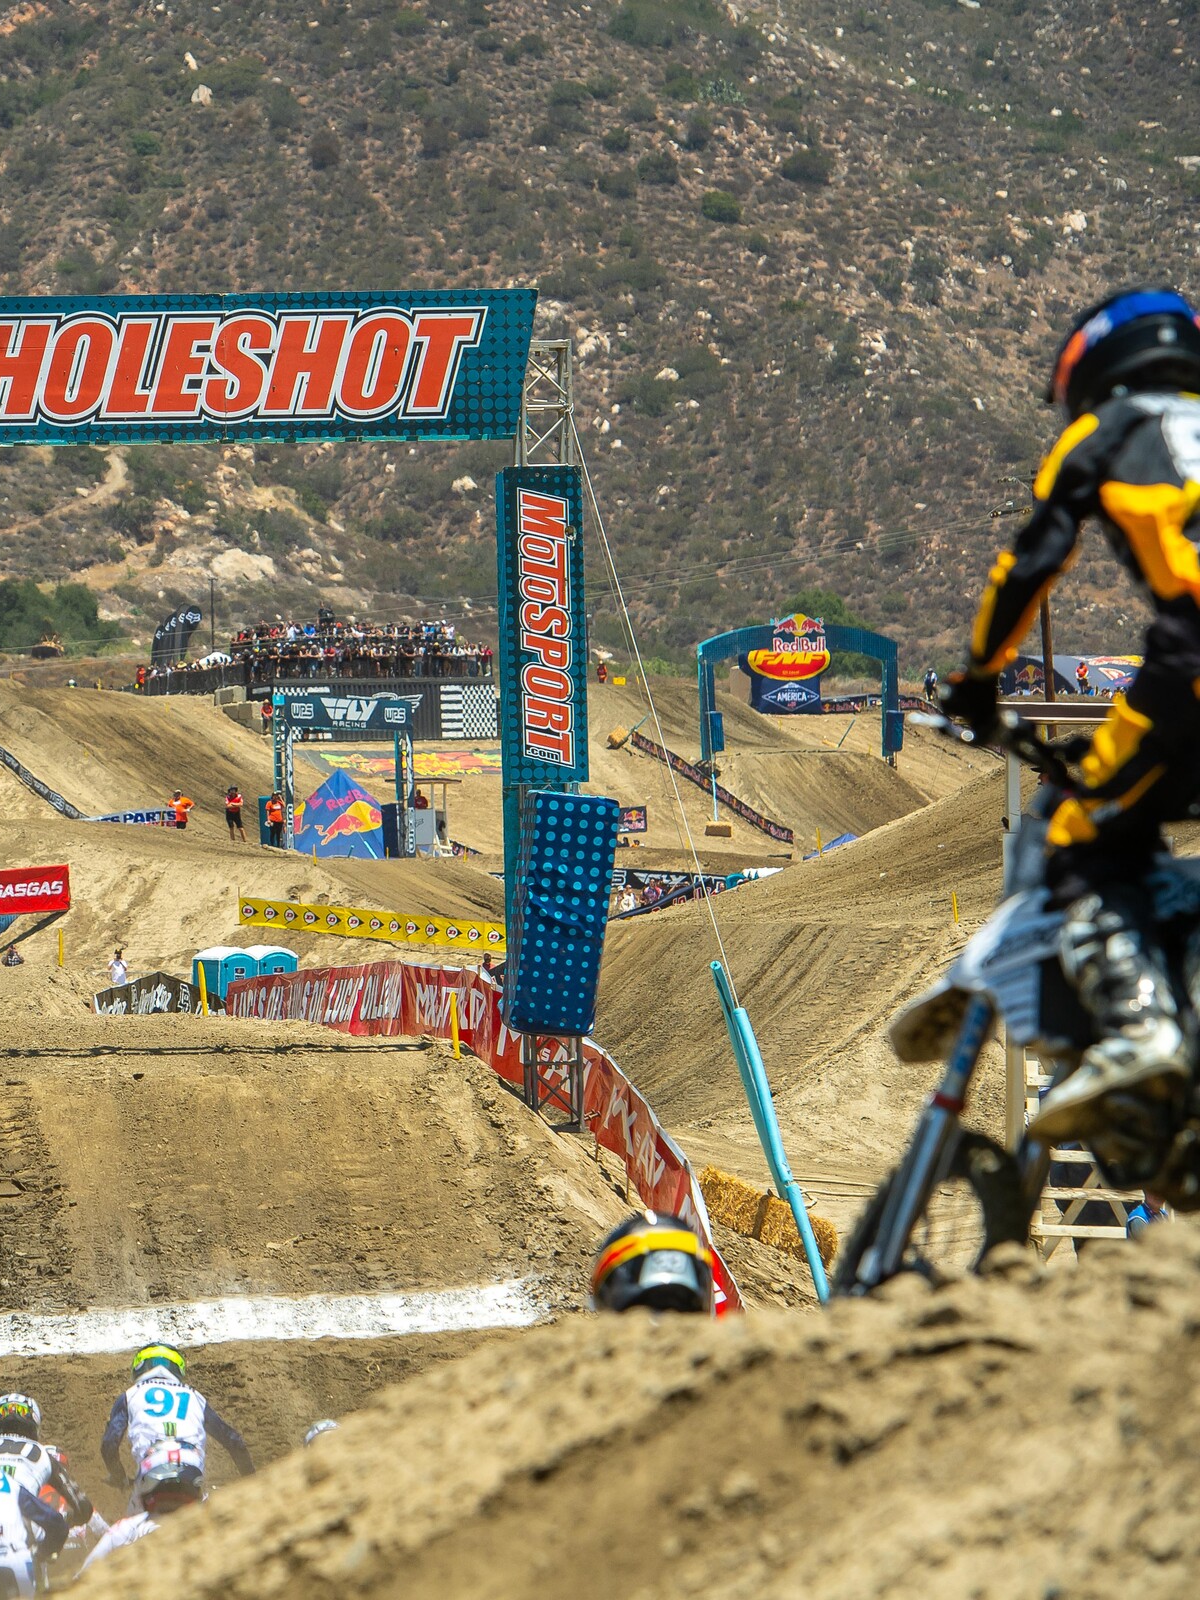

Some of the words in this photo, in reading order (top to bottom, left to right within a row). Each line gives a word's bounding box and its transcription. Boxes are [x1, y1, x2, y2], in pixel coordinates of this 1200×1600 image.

[773, 636, 799, 653] Red
[800, 636, 826, 653] Bull
[754, 649, 824, 666] FMF
[777, 692, 807, 701] AMERICA
[320, 697, 378, 721] FLY
[332, 720, 366, 728] RACING
[325, 790, 356, 811] Red
[123, 811, 176, 823] PARTS
[144, 1387, 190, 1420] 91
